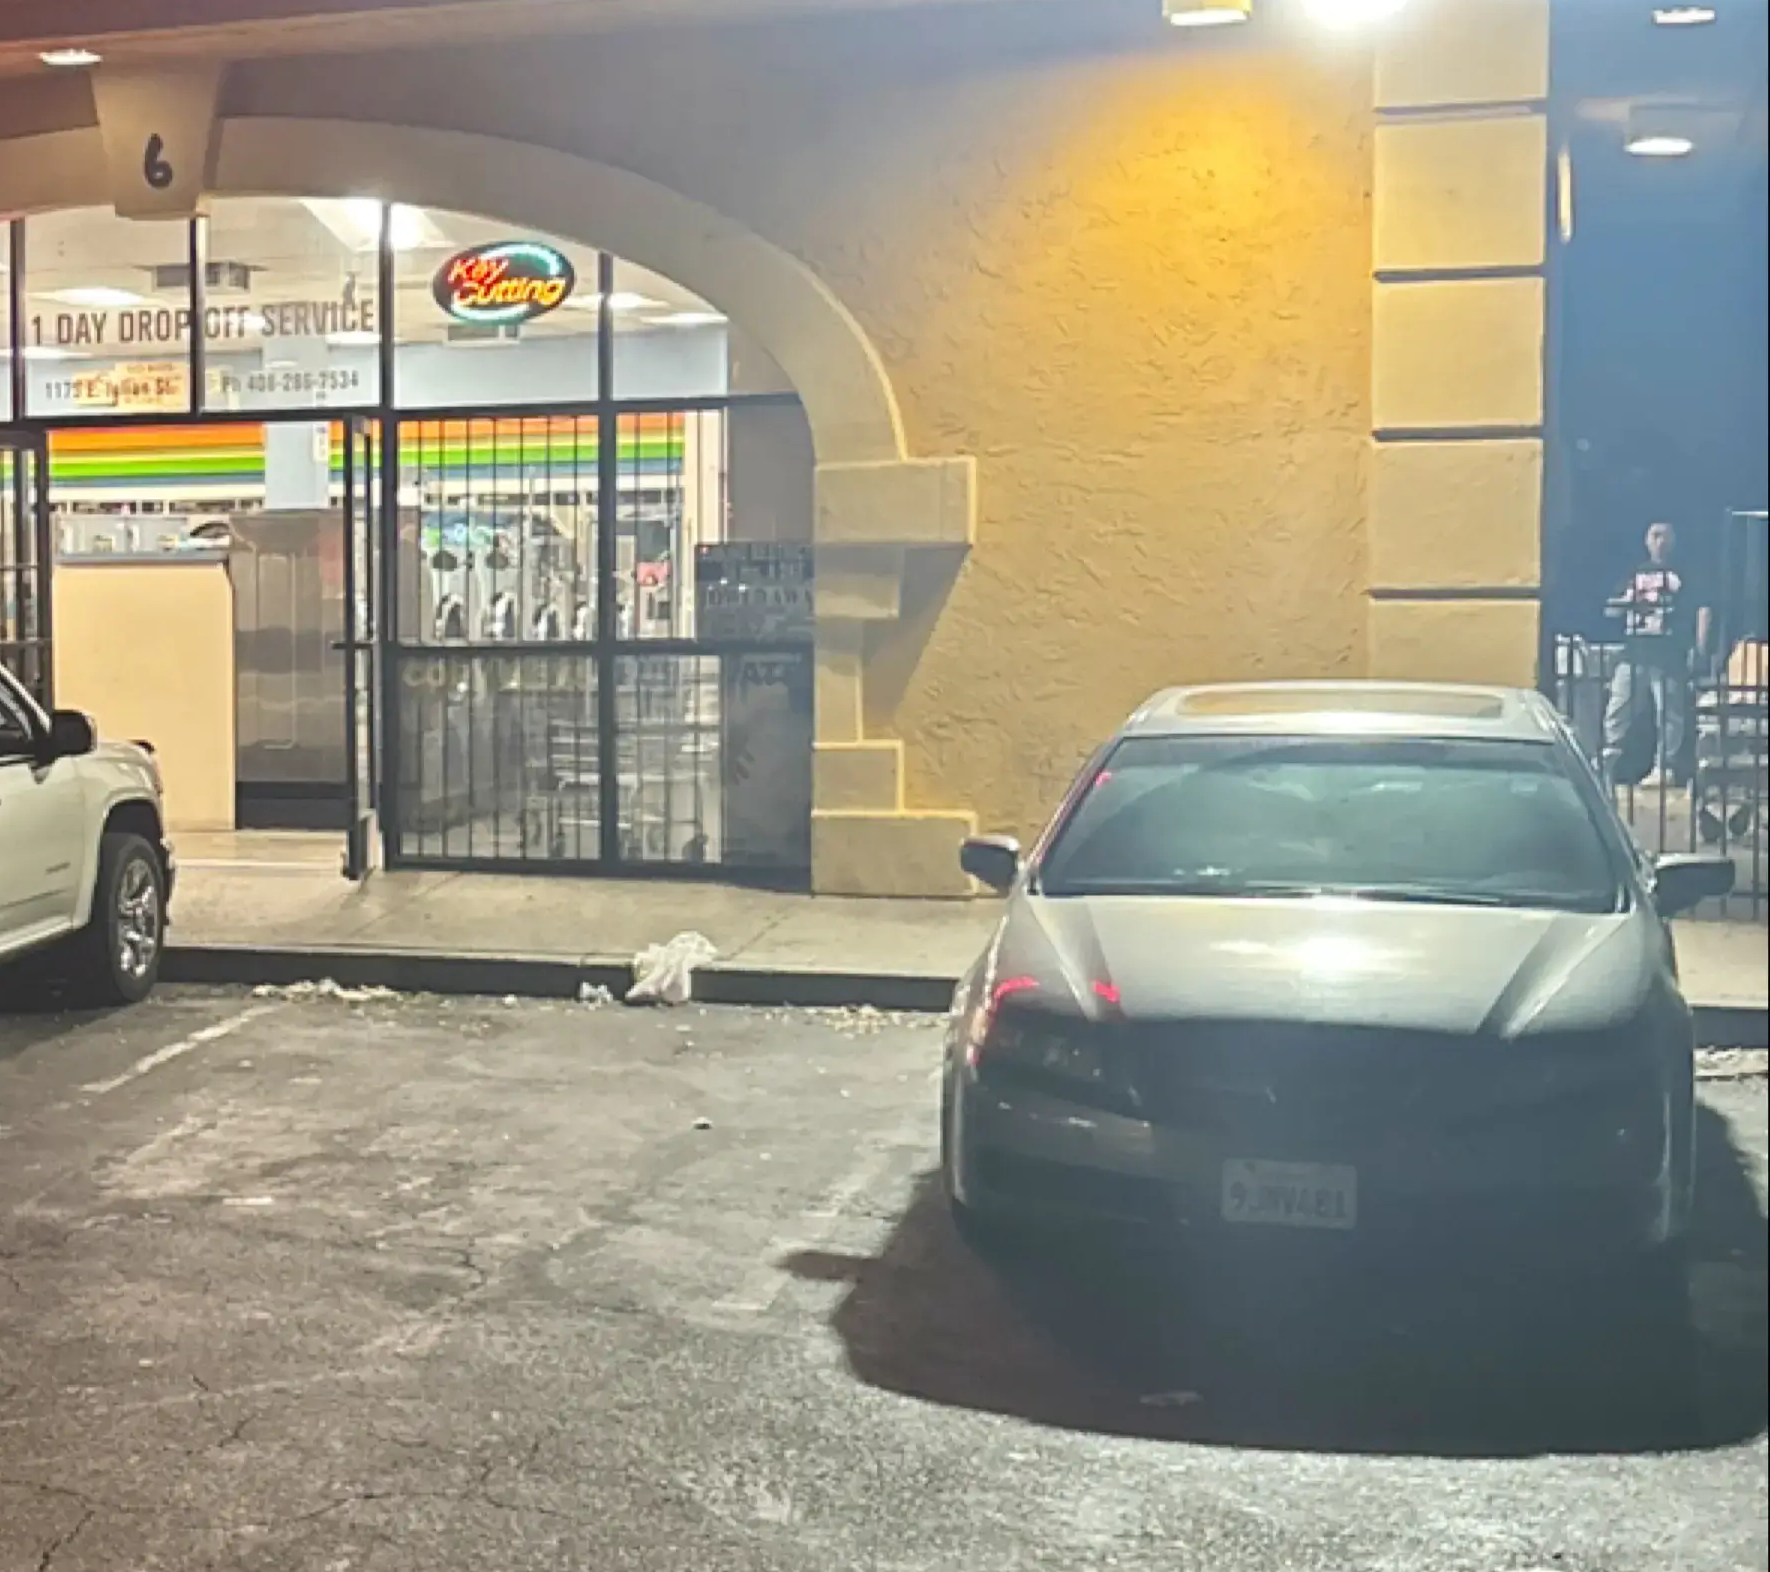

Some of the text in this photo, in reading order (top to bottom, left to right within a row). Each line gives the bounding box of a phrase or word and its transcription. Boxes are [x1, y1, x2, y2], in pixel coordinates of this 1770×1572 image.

[144, 133, 173, 189] 6
[448, 257, 509, 285] Key
[453, 278, 566, 306] Cutting
[32, 298, 374, 345] 1 DAY DROP OFF SERVICE
